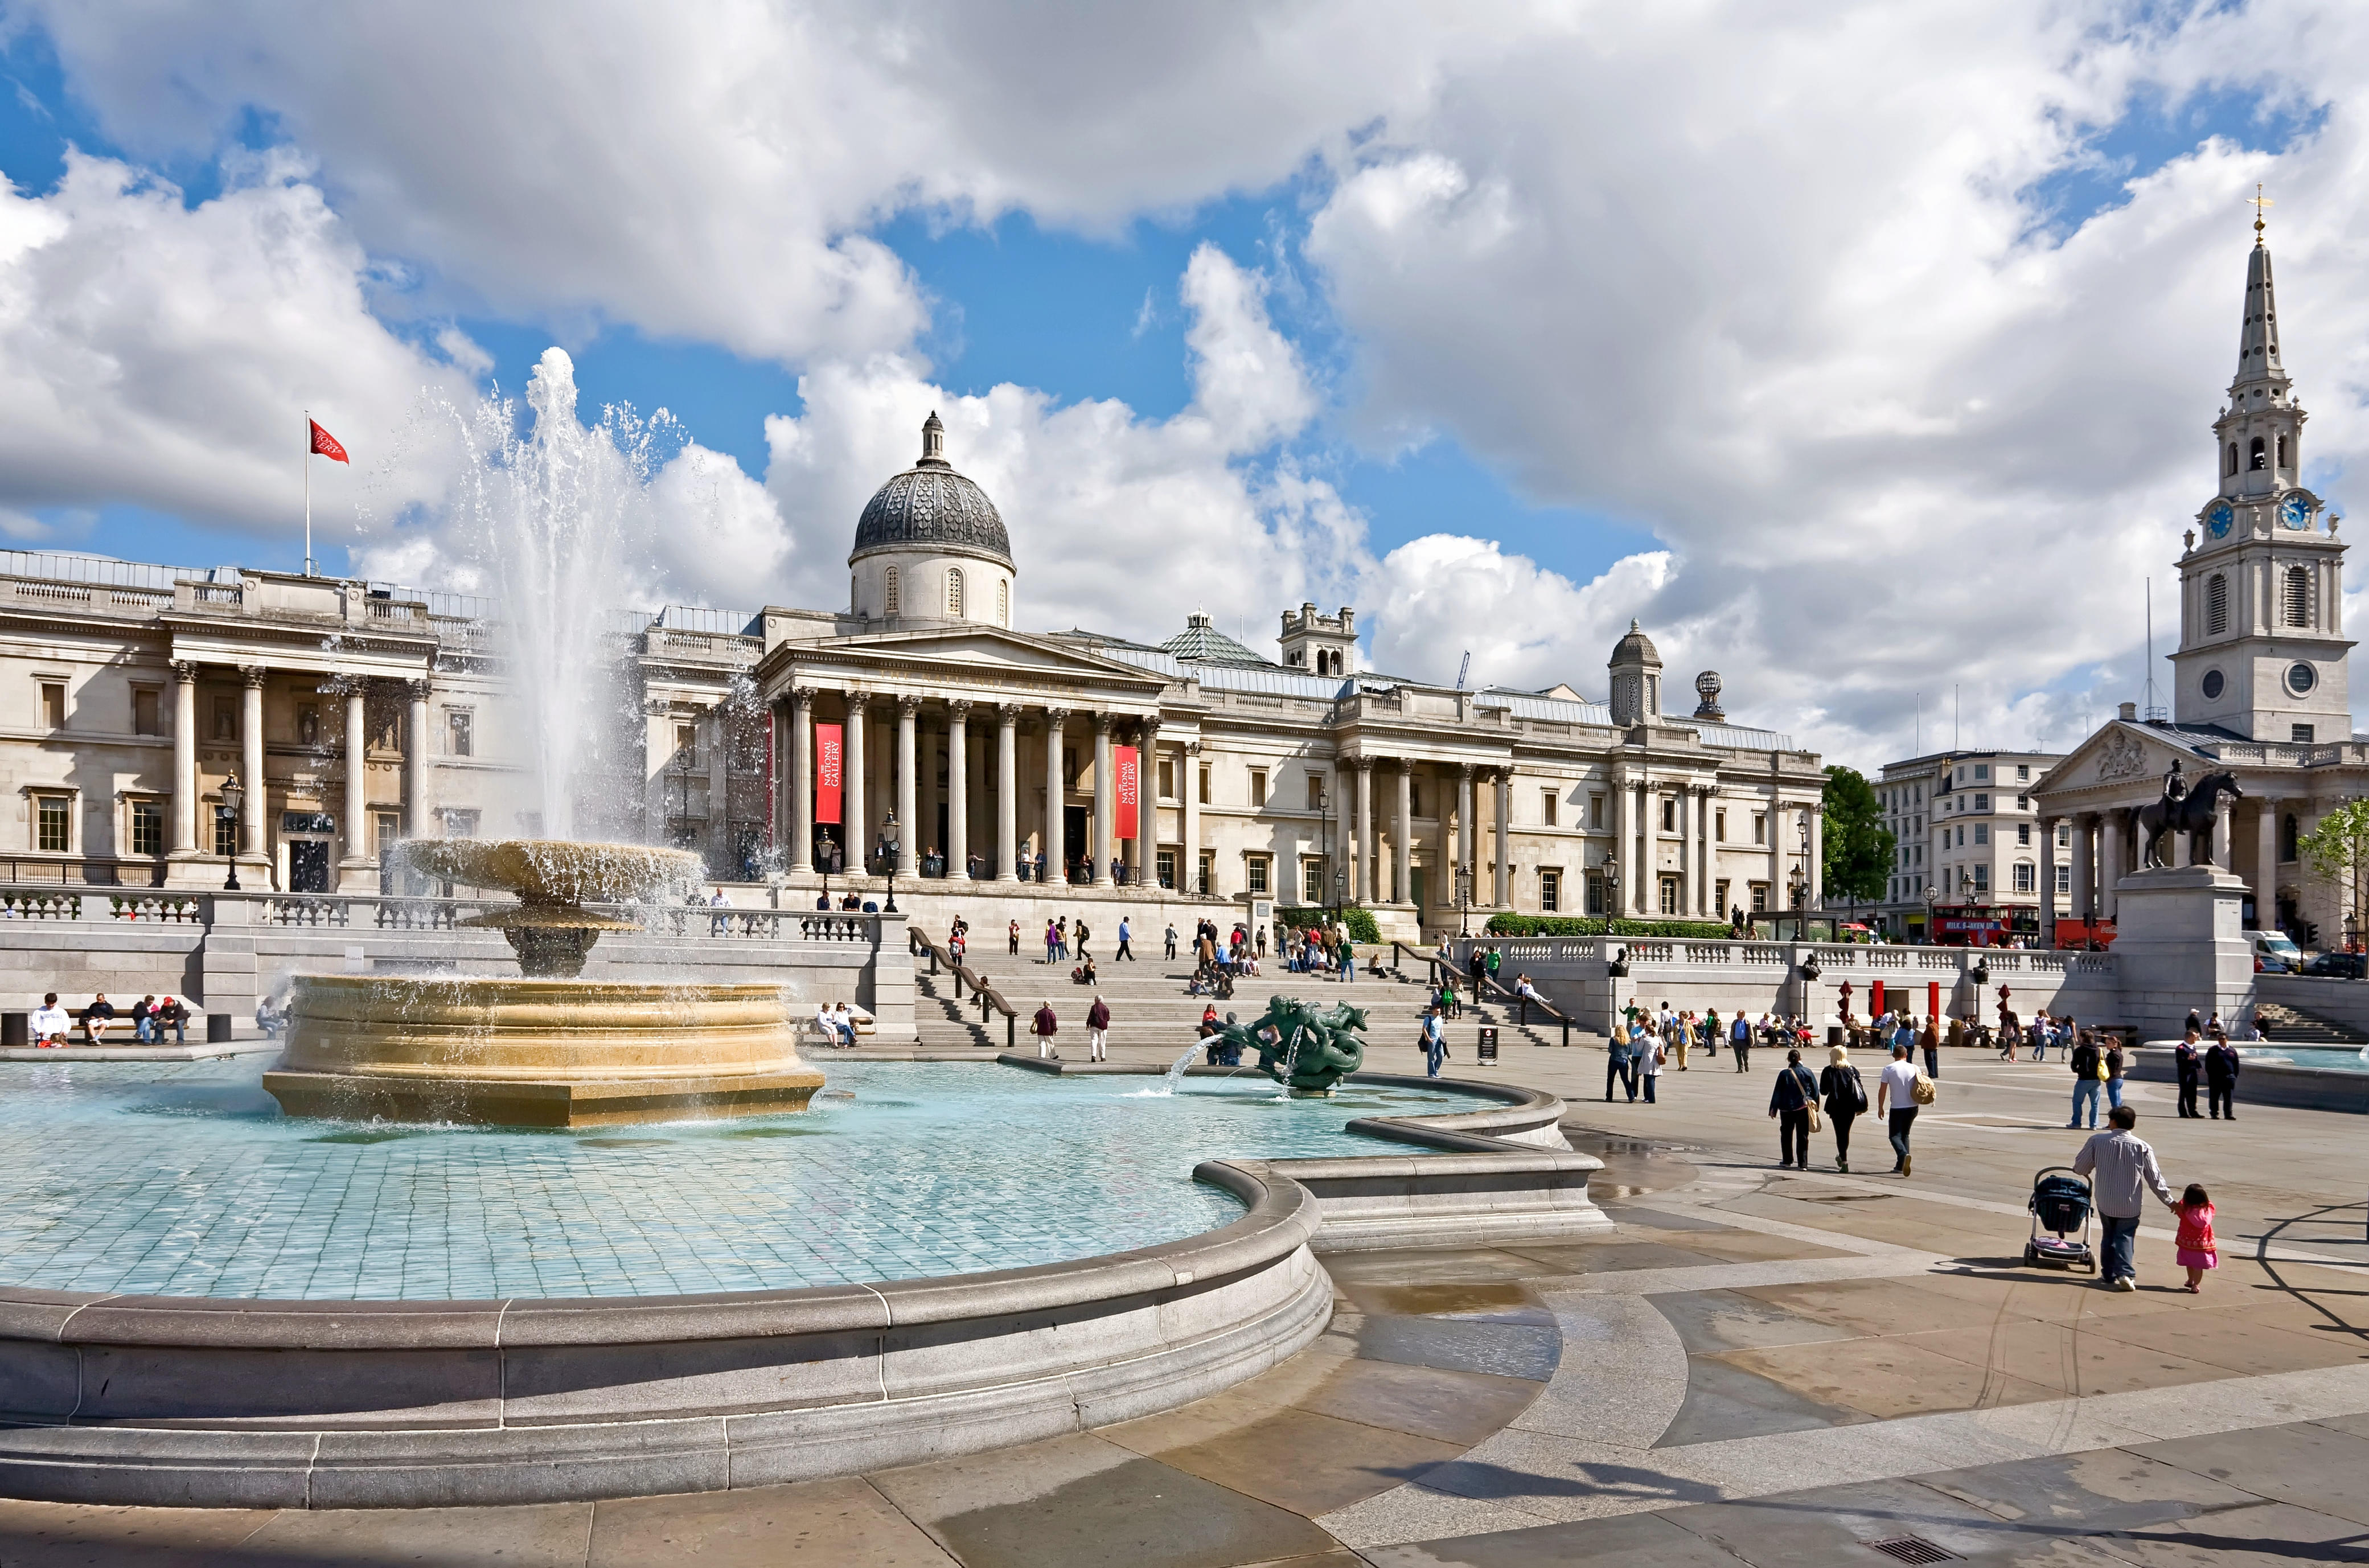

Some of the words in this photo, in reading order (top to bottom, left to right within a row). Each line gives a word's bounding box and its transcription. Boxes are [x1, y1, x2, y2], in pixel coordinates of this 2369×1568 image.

[879, 669, 909, 680] THE
[922, 674, 1002, 688] NATIONAL
[1015, 682, 1085, 697] GALLERY
